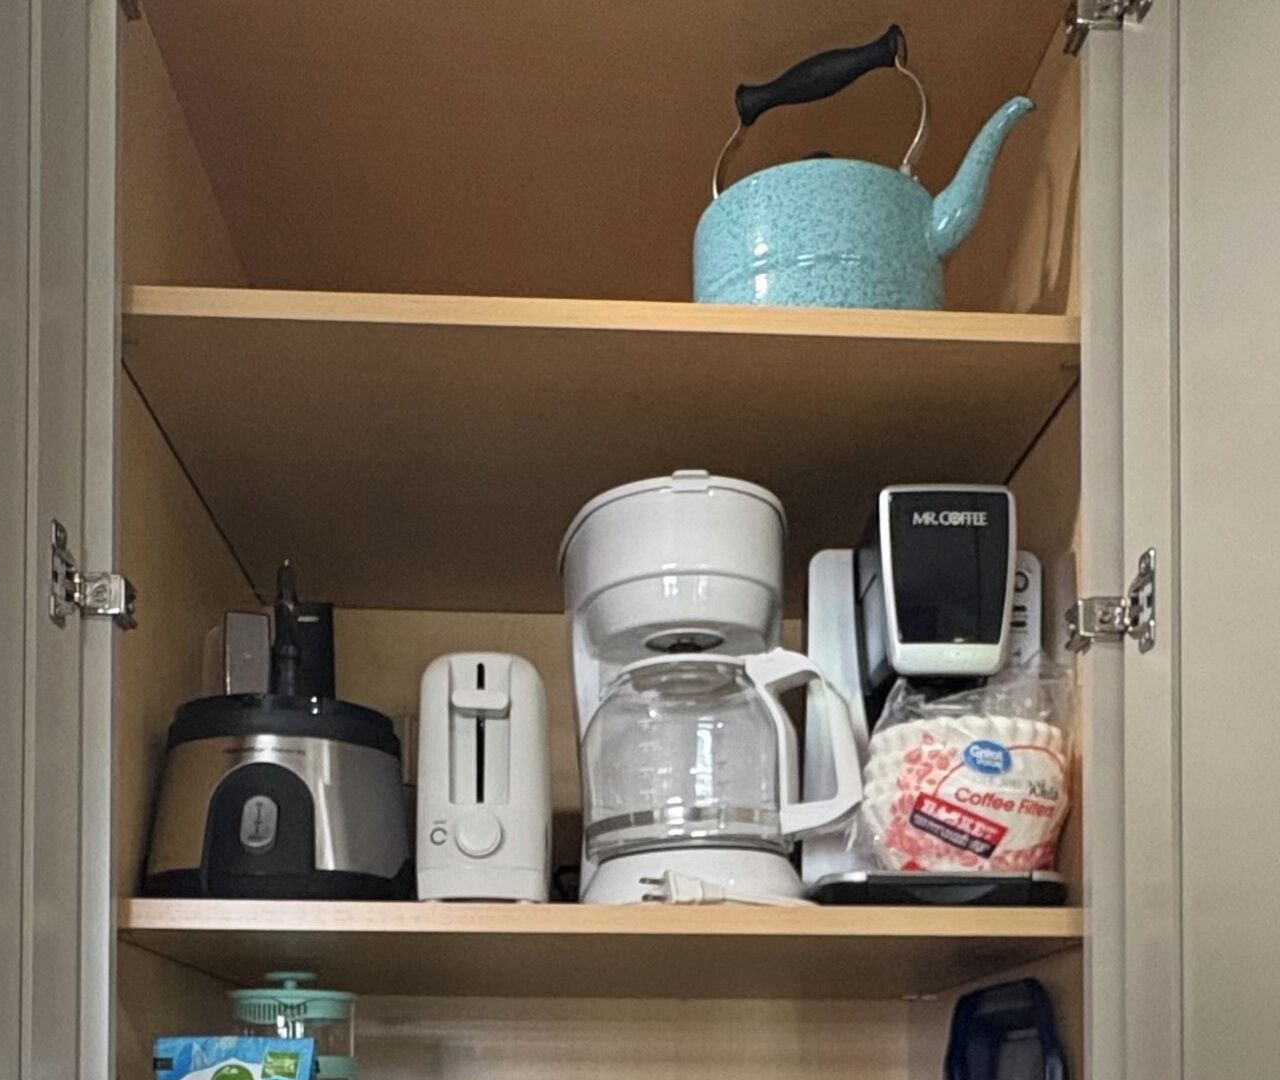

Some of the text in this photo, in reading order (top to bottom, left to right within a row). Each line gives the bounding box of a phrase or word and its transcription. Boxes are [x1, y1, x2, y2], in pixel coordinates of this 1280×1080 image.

[912, 511, 988, 526] MR. COFFEE
[953, 786, 1016, 813] Coffee
